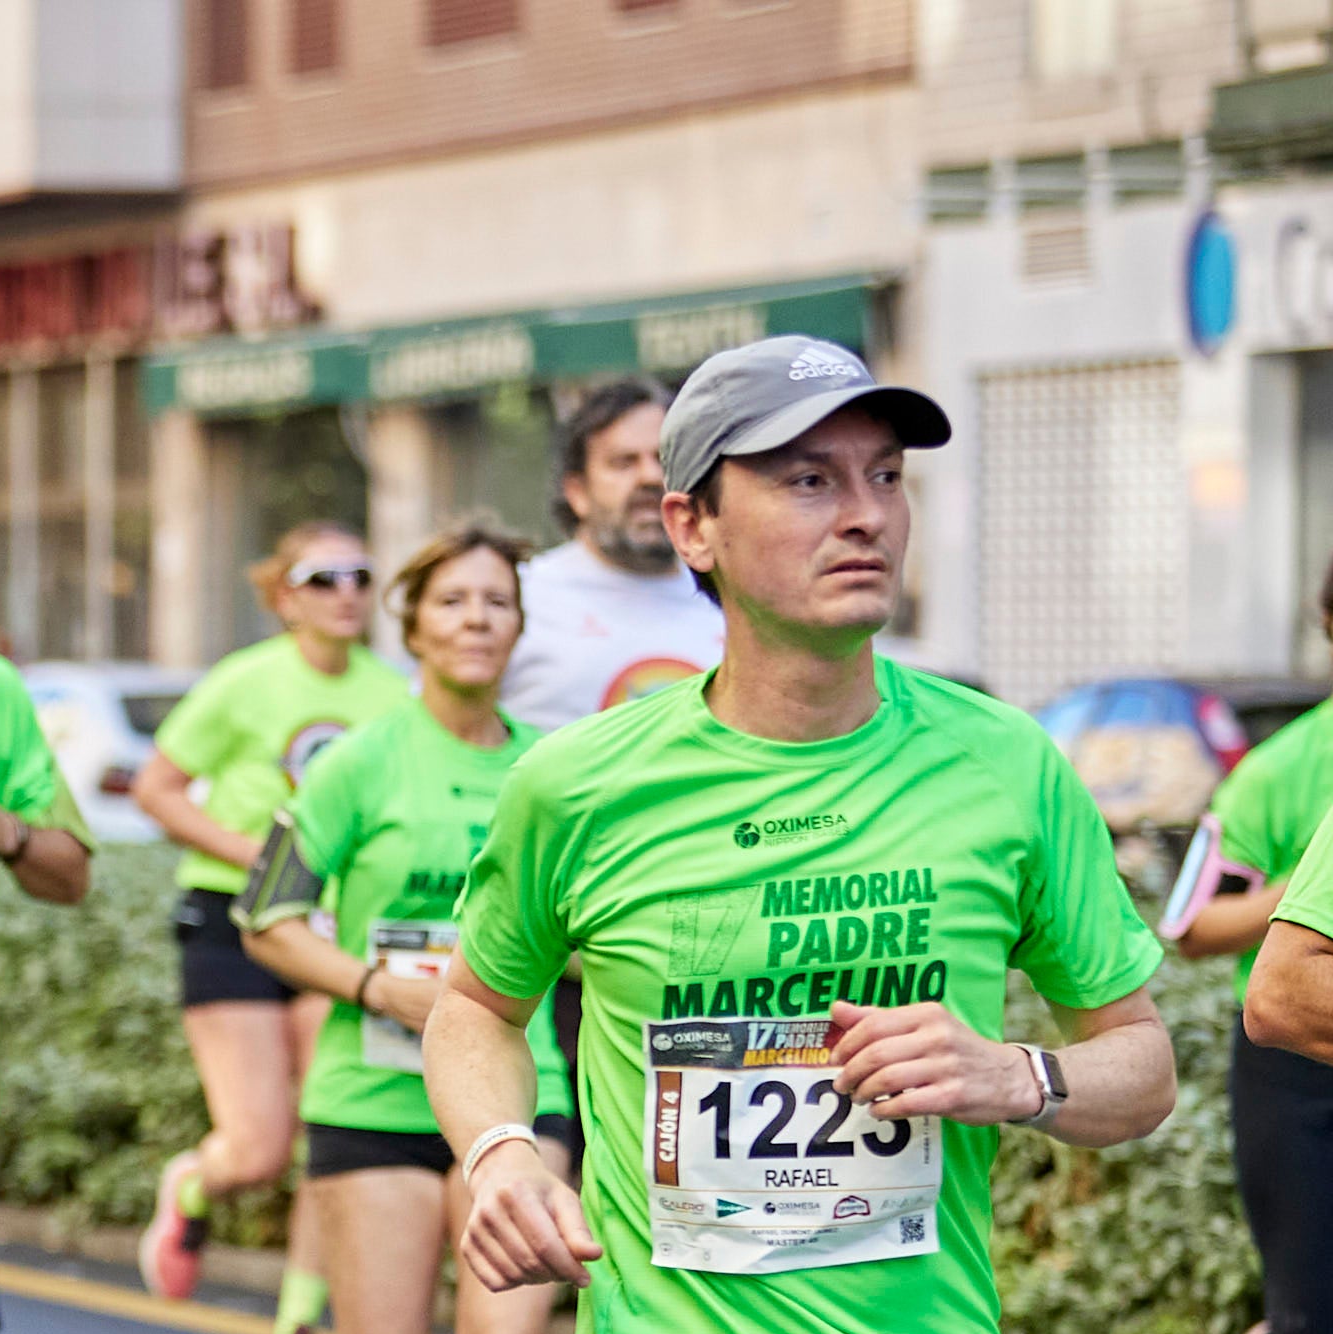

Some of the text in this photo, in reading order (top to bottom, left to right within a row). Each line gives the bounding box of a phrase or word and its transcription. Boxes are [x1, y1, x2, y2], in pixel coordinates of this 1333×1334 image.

[789, 364, 860, 381] adidas
[763, 814, 848, 835] OXIMESA
[761, 868, 938, 918] MEMORIAL
[767, 908, 931, 969] PADRE
[662, 959, 948, 1019] MARCELINO
[673, 1032, 730, 1043] OXIMESA
[747, 1023, 776, 1050] 17
[775, 1034, 825, 1049] PADRE
[743, 1048, 830, 1067] MARCELINO
[657, 1091, 680, 1163] CAJÓN 4
[764, 1168, 839, 1188] RAFAEL
